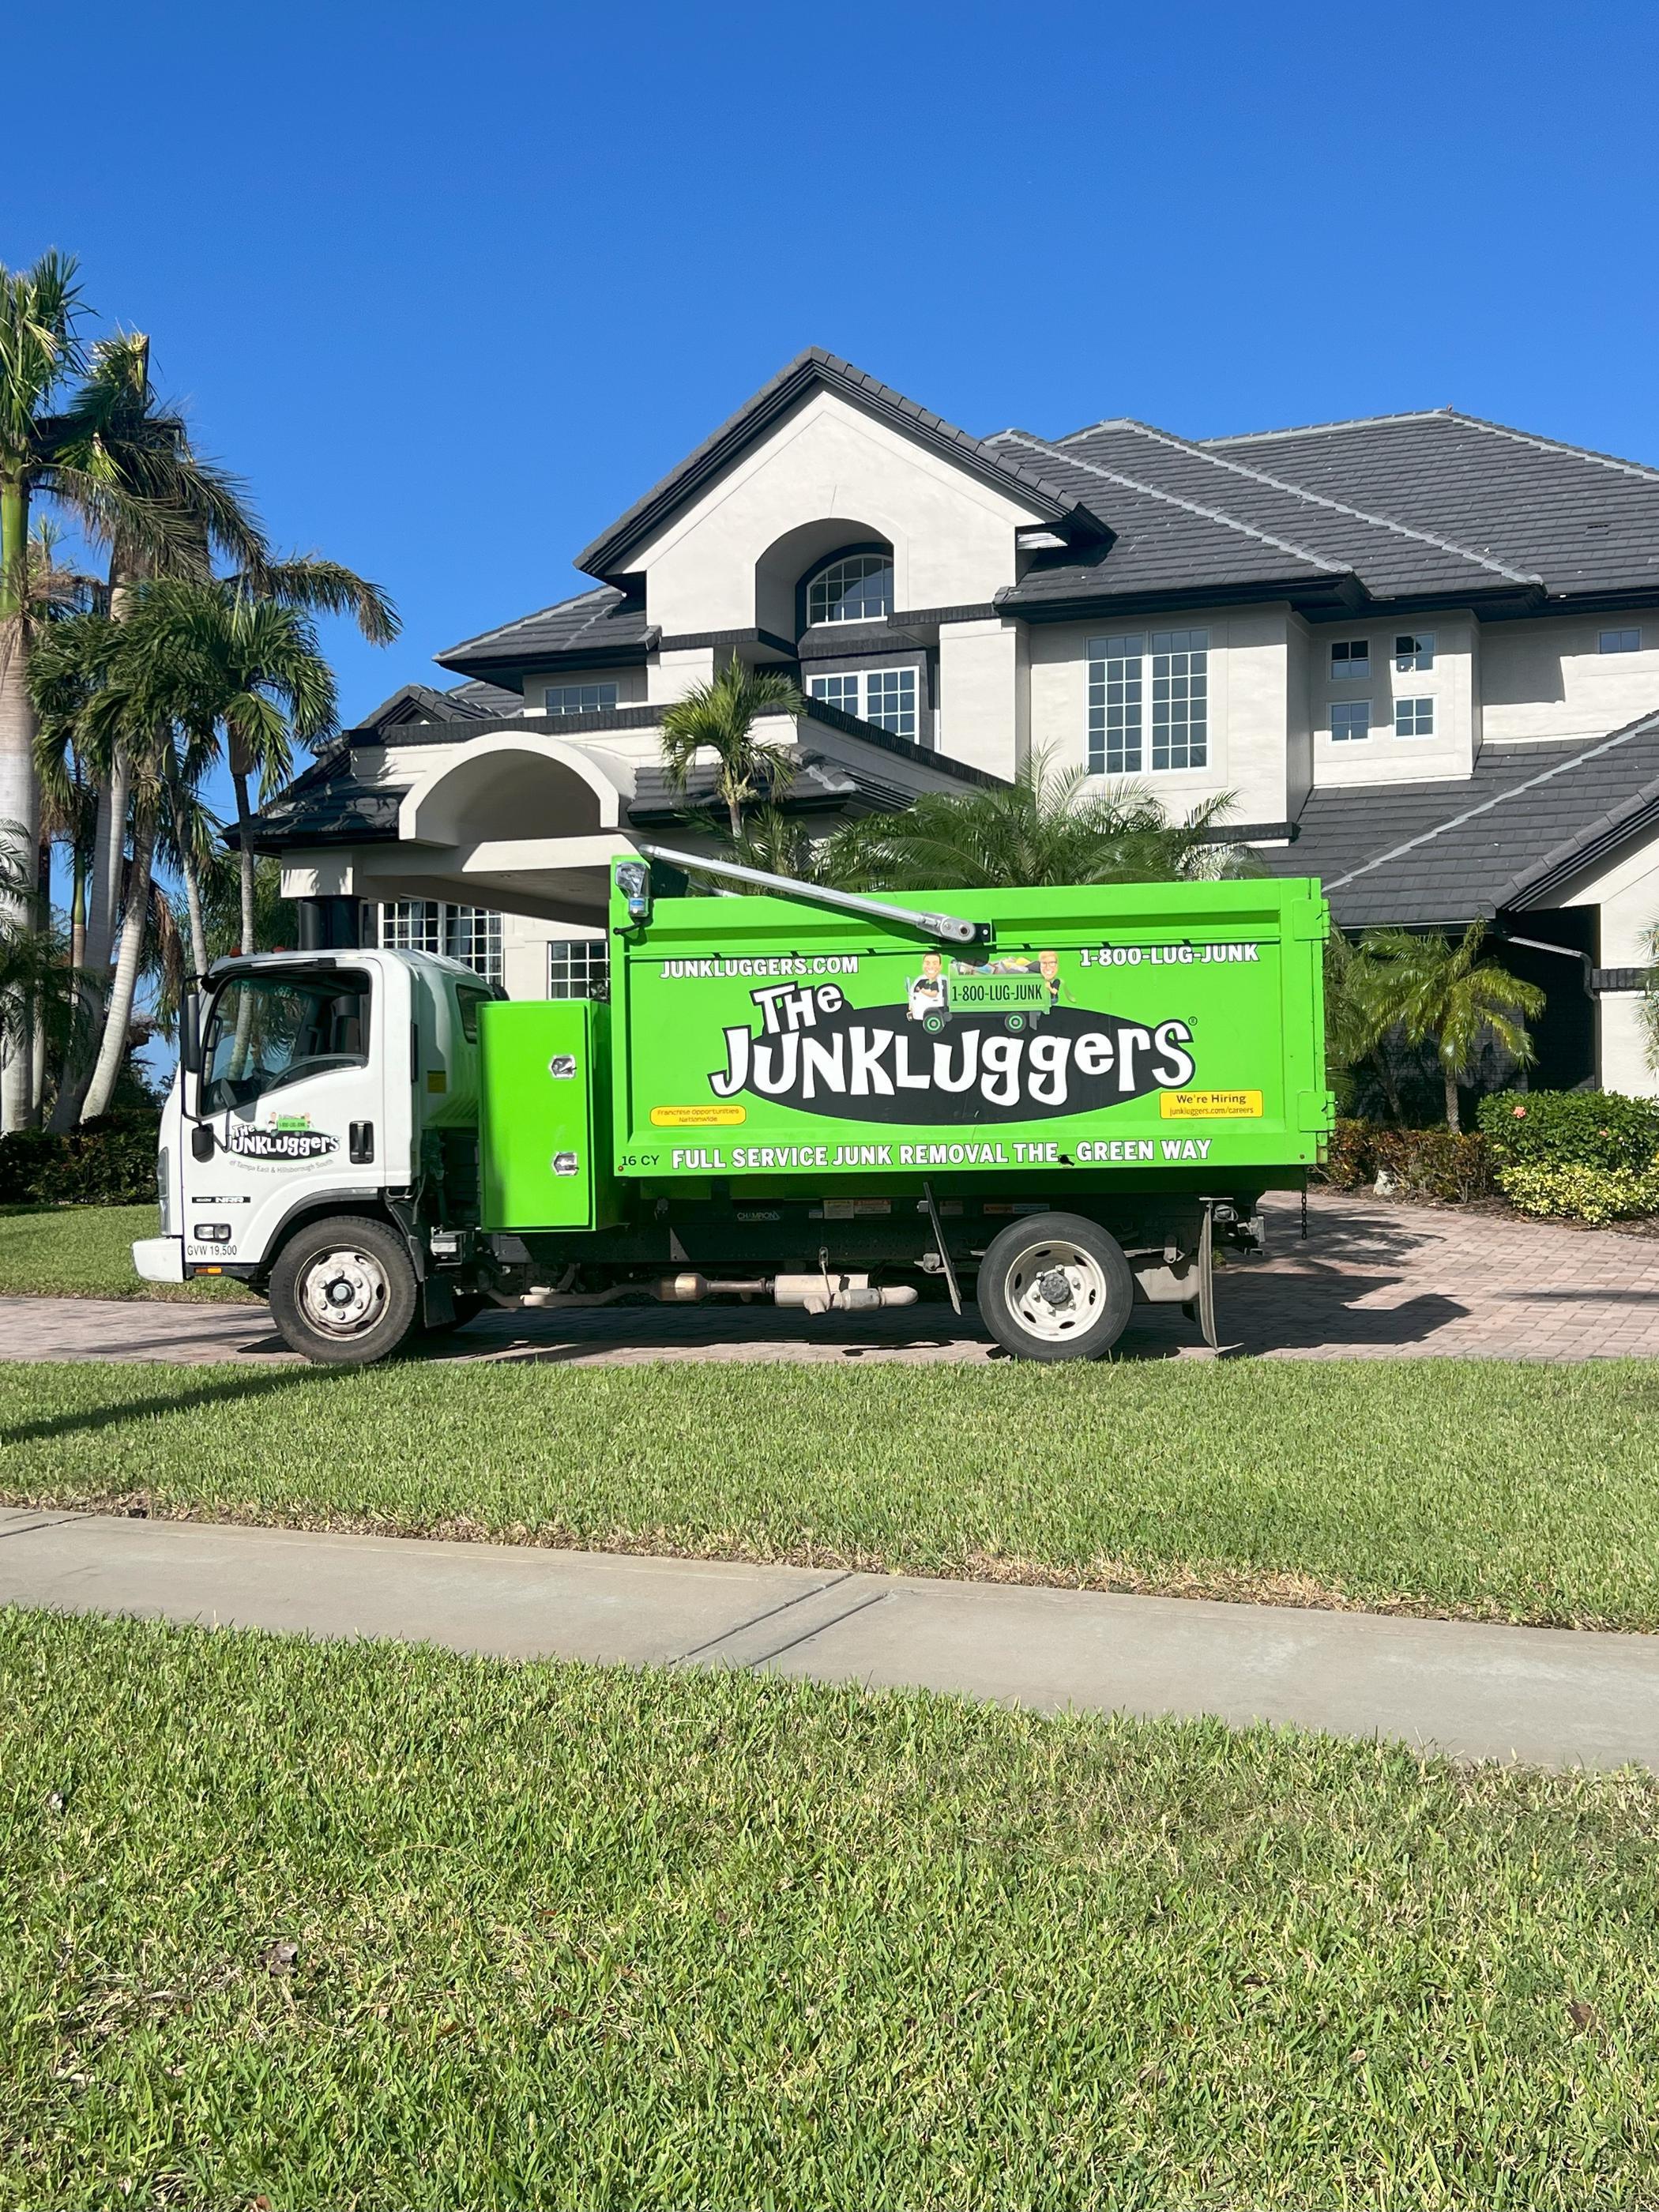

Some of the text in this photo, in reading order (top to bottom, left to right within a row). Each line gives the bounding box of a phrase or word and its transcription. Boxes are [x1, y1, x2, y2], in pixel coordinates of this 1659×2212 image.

[1080, 943, 1259, 967] 1-800-LUG-JUNK
[659, 956, 859, 979] JUNKLUGGERS.COM
[952, 984, 1043, 1002] 1-800-LUG-JUNK
[1176, 1094, 1247, 1104] We're Hiring
[1169, 1106, 1255, 1117] junkluggers.com/careers
[622, 1155, 660, 1166] 16 CY
[672, 1138, 1212, 1169] FULL SERVICE JUNK REMOVAL THE GREEN WAY
[187, 1244, 238, 1257] GVW 19,500
